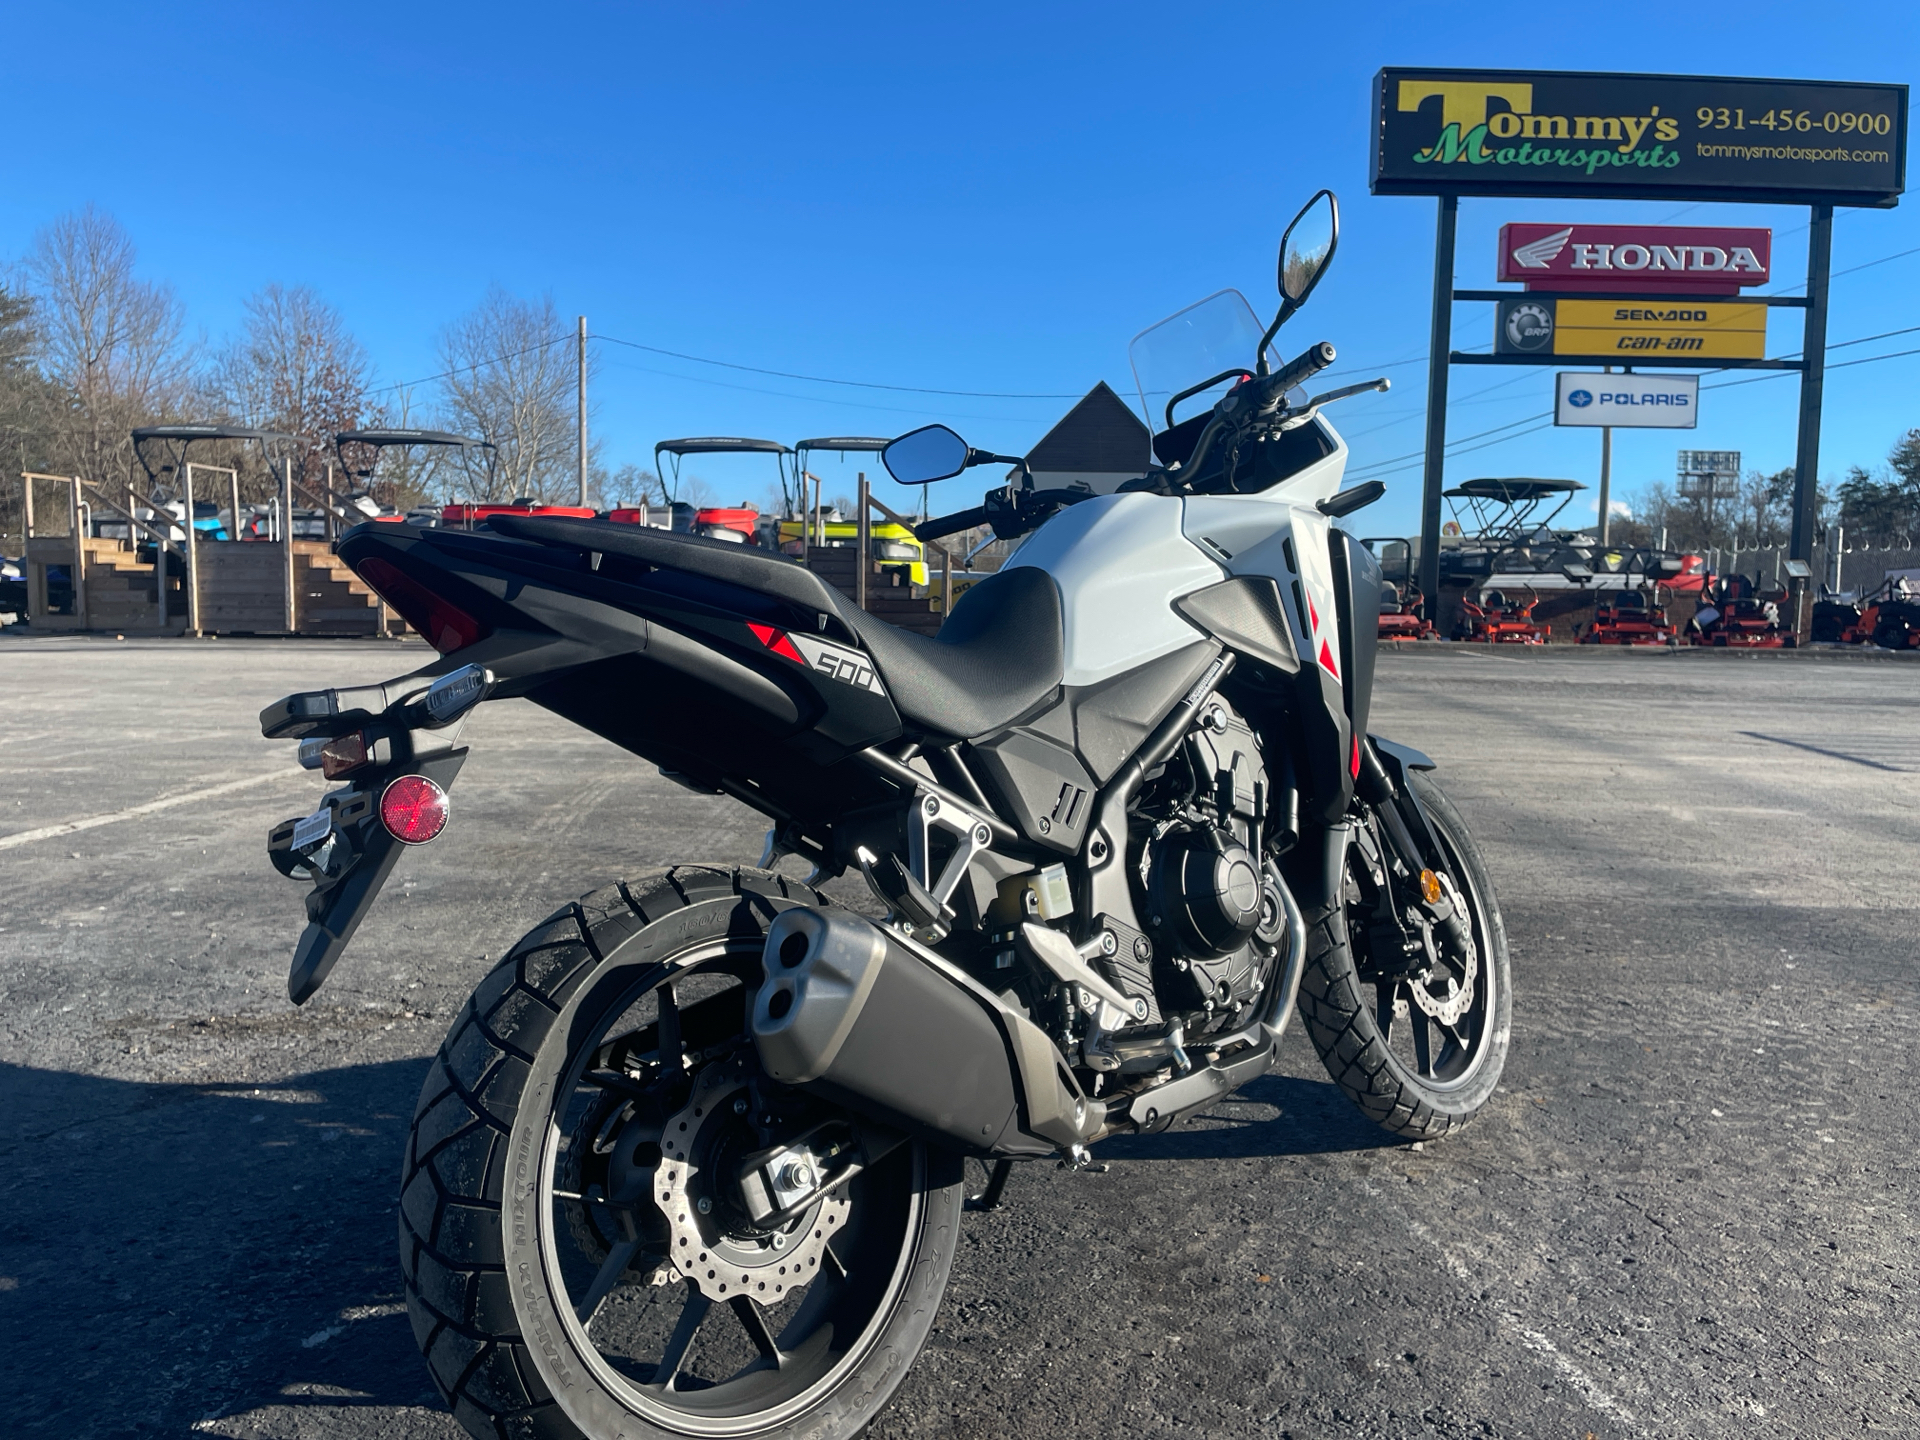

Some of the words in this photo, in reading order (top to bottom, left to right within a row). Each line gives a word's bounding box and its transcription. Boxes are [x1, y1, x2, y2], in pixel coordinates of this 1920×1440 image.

[1397, 80, 1680, 162] Tommy's
[1696, 107, 1891, 136] 931-456-0900
[1412, 122, 1681, 175] Motorsports
[1696, 142, 1889, 163] tommysmotorsports.com
[1570, 243, 1766, 273] HONDA
[1524, 327, 1550, 337] BRP
[1616, 335, 1704, 350] can-am
[1599, 393, 1689, 406] POLARIS
[814, 652, 874, 691] 500
[512, 1125, 534, 1247] MIXTOUR
[518, 1261, 575, 1389] TRAILMAX
